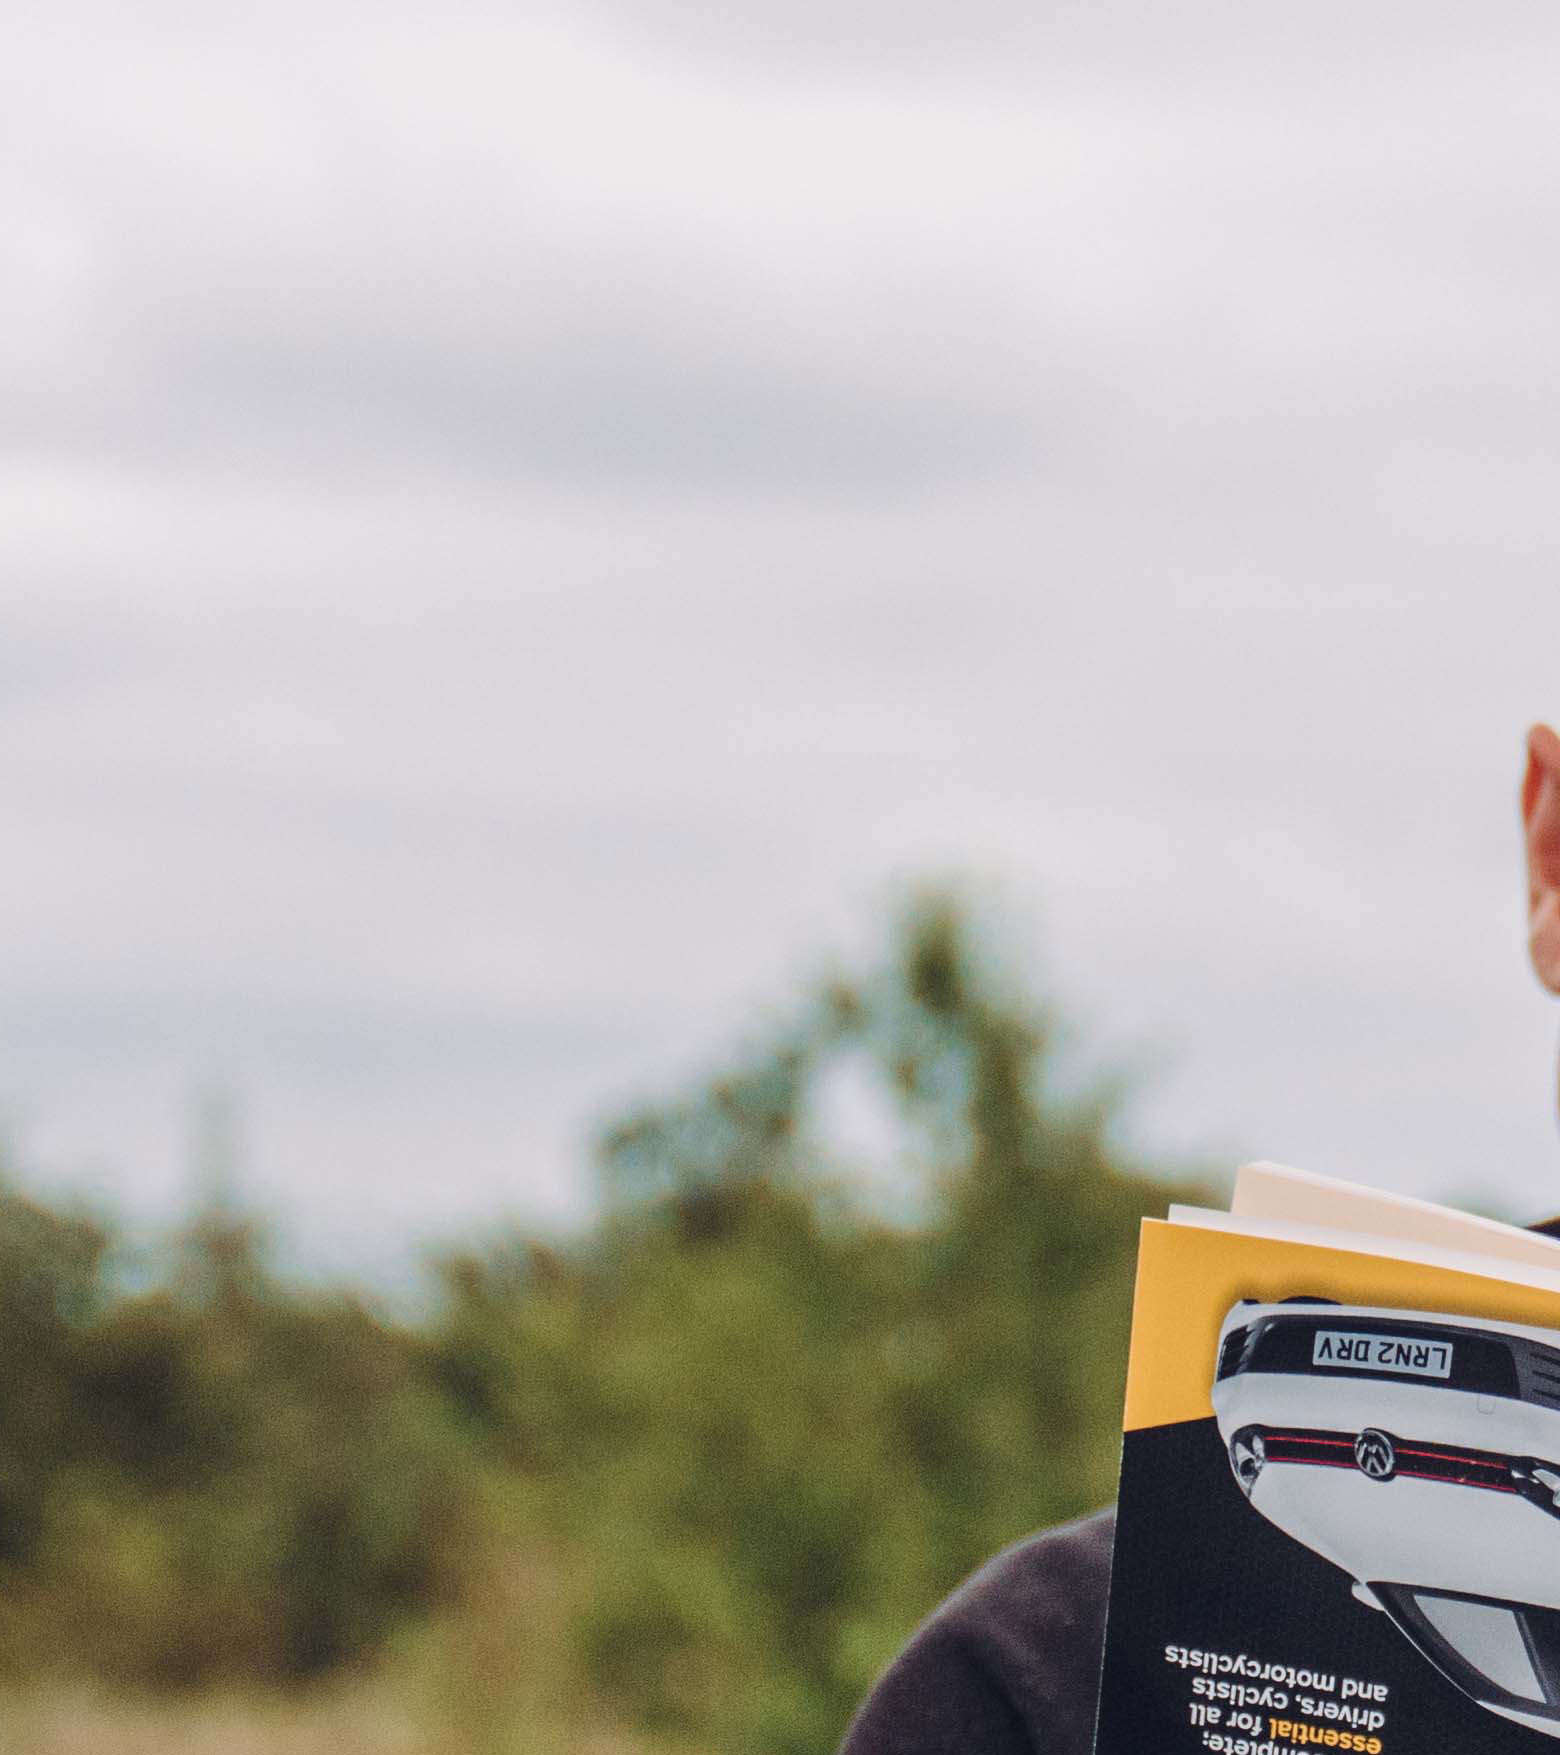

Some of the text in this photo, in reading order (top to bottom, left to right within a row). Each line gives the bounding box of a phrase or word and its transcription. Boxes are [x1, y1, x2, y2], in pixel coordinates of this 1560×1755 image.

[1317, 1334, 1448, 1372] LRN2 DRV
[1164, 1644, 1388, 1704] and motorcyclists
[1189, 1702, 1221, 1728] all
[1191, 1675, 1385, 1731] drivers, cyclists
[1226, 1710, 1263, 1737] for
